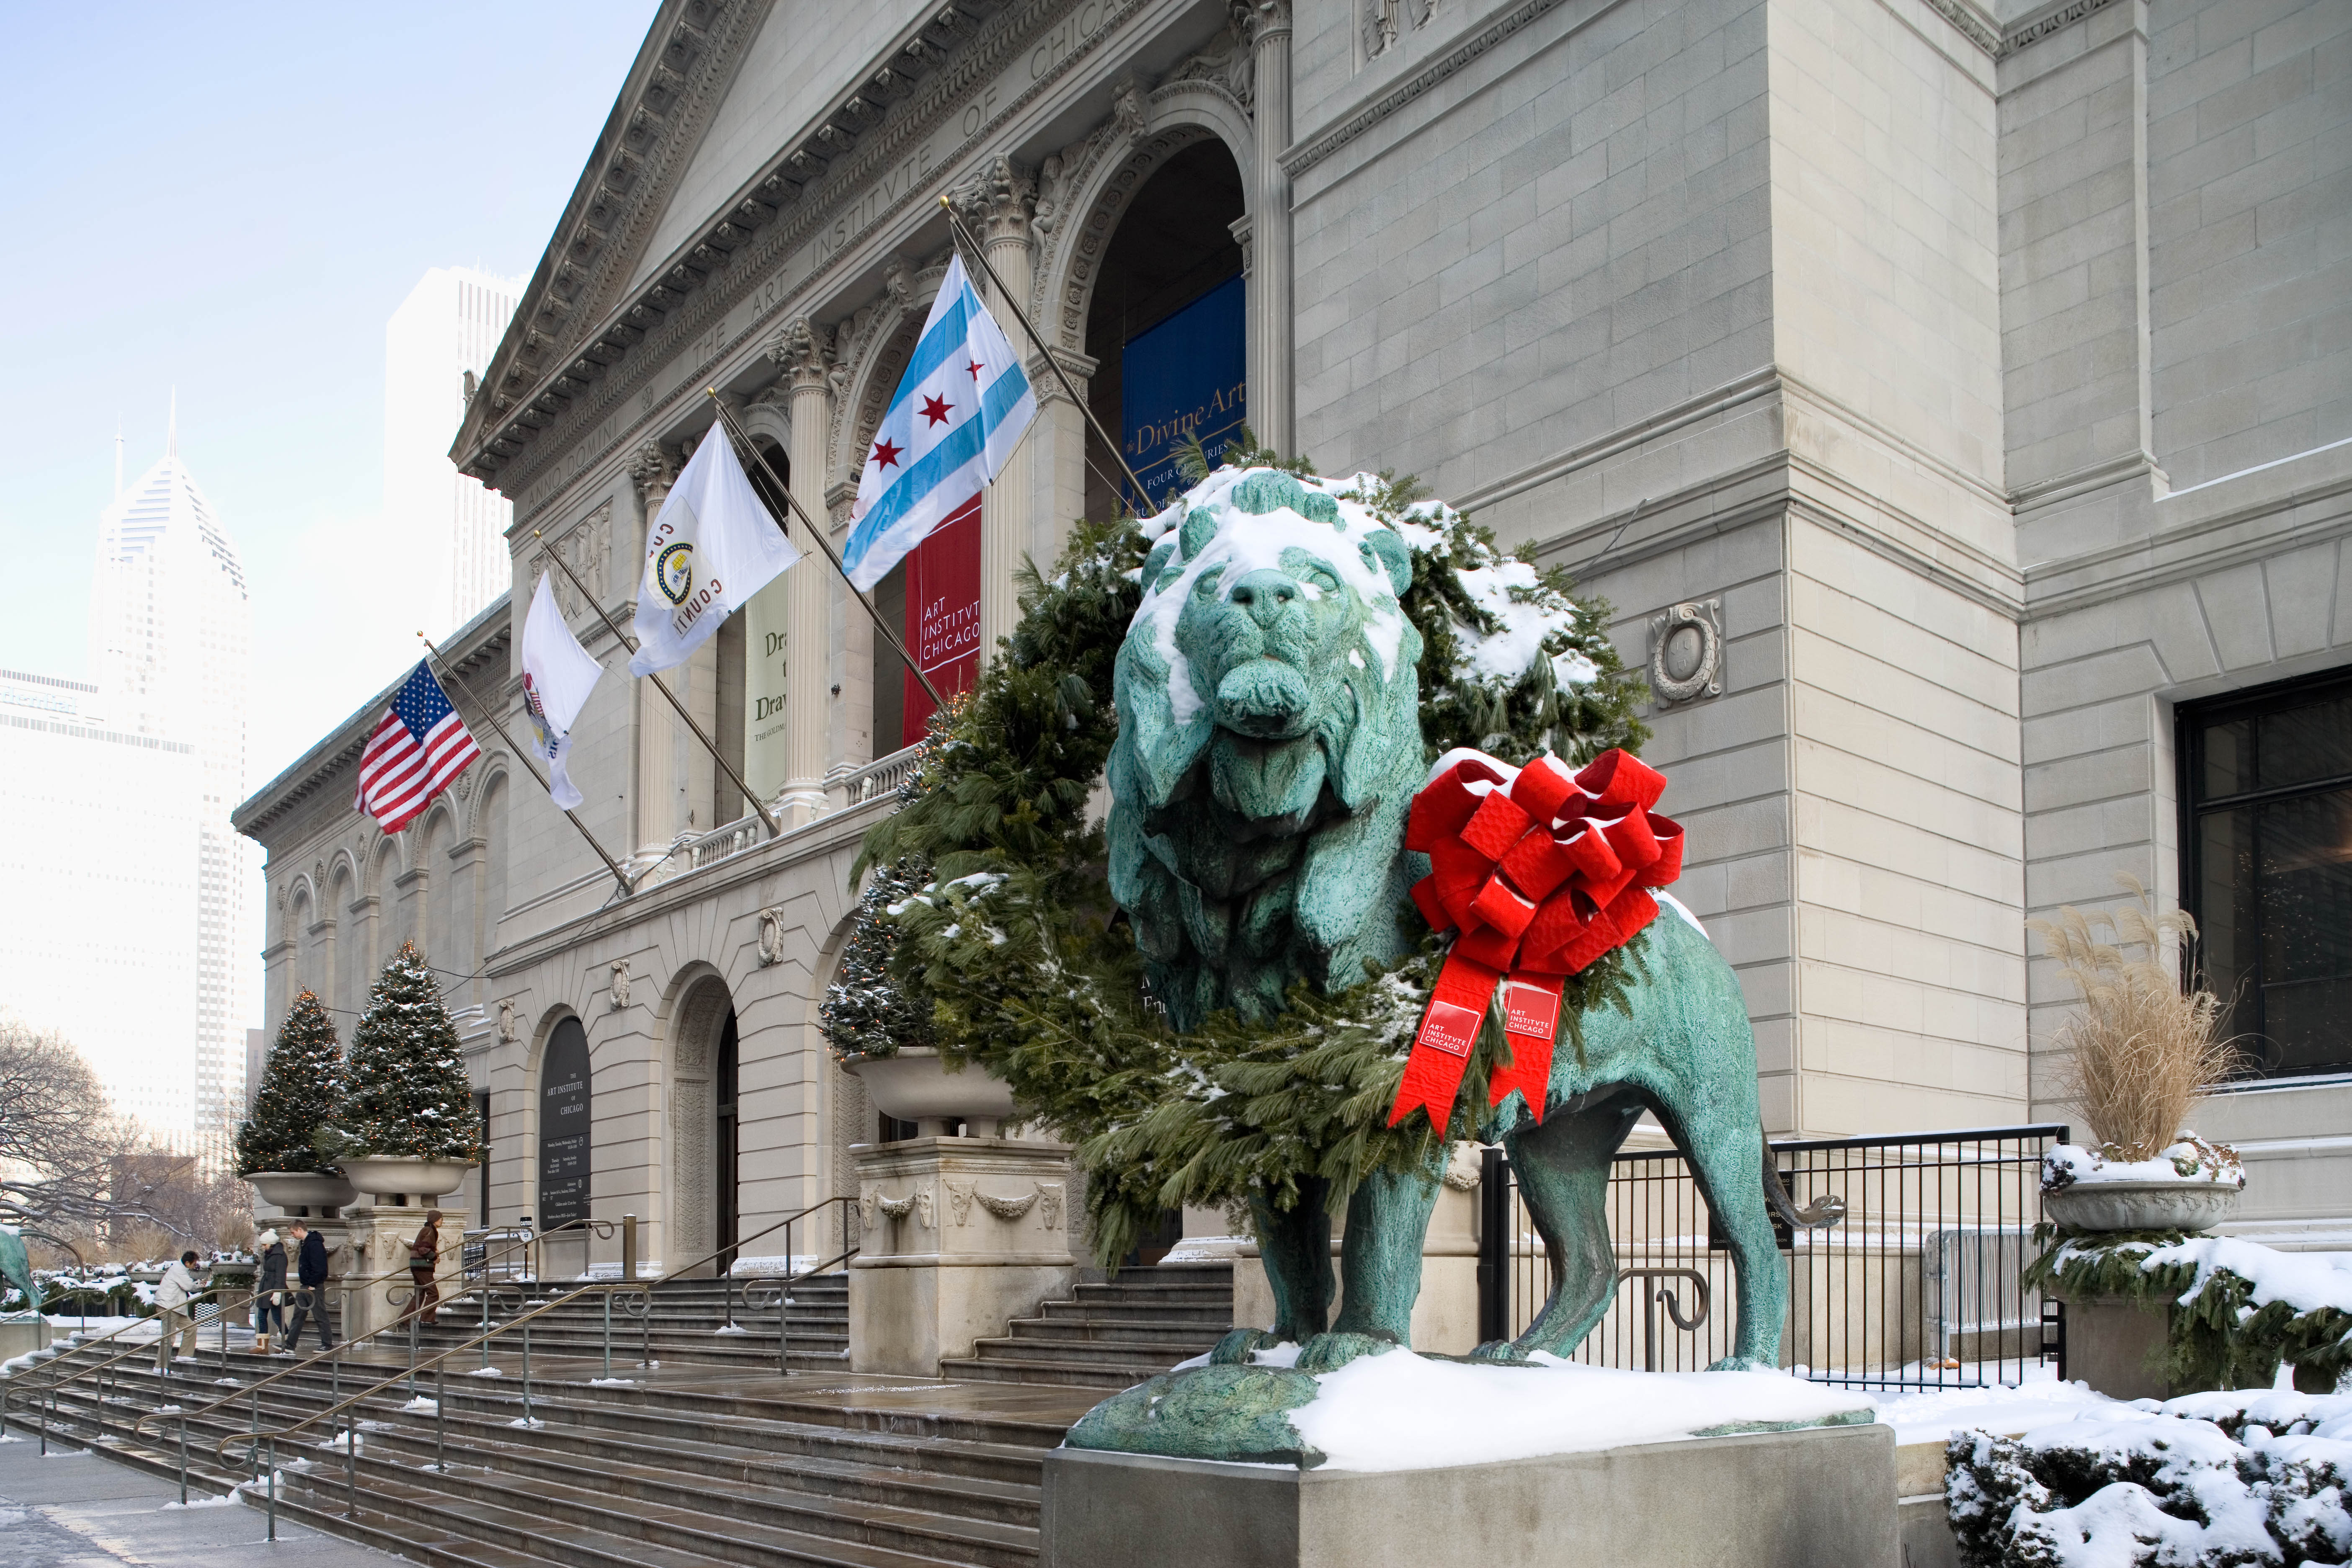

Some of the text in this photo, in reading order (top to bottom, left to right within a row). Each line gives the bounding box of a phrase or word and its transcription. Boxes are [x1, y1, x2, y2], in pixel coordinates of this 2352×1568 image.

[693, 0, 1130, 368] THE ART INSTITVTE OF CHICA
[1136, 410, 1204, 456] Divine
[528, 417, 617, 511] ANNO DOMINI
[1147, 469, 1174, 490] FOUR
[924, 596, 945, 621] ART
[923, 622, 980, 660] CHICAGO
[754, 731, 766, 741] THE
[1509, 1022, 1543, 1034] CHICAGO
[1510, 1015, 1549, 1029] INSTITVTE
[1425, 1036, 1460, 1050] CHICAGO
[1427, 1029, 1467, 1046] INSTITVTE
[547, 1081, 583, 1096] ART INSTITUTE
[561, 1103, 583, 1115] CHICAGO
